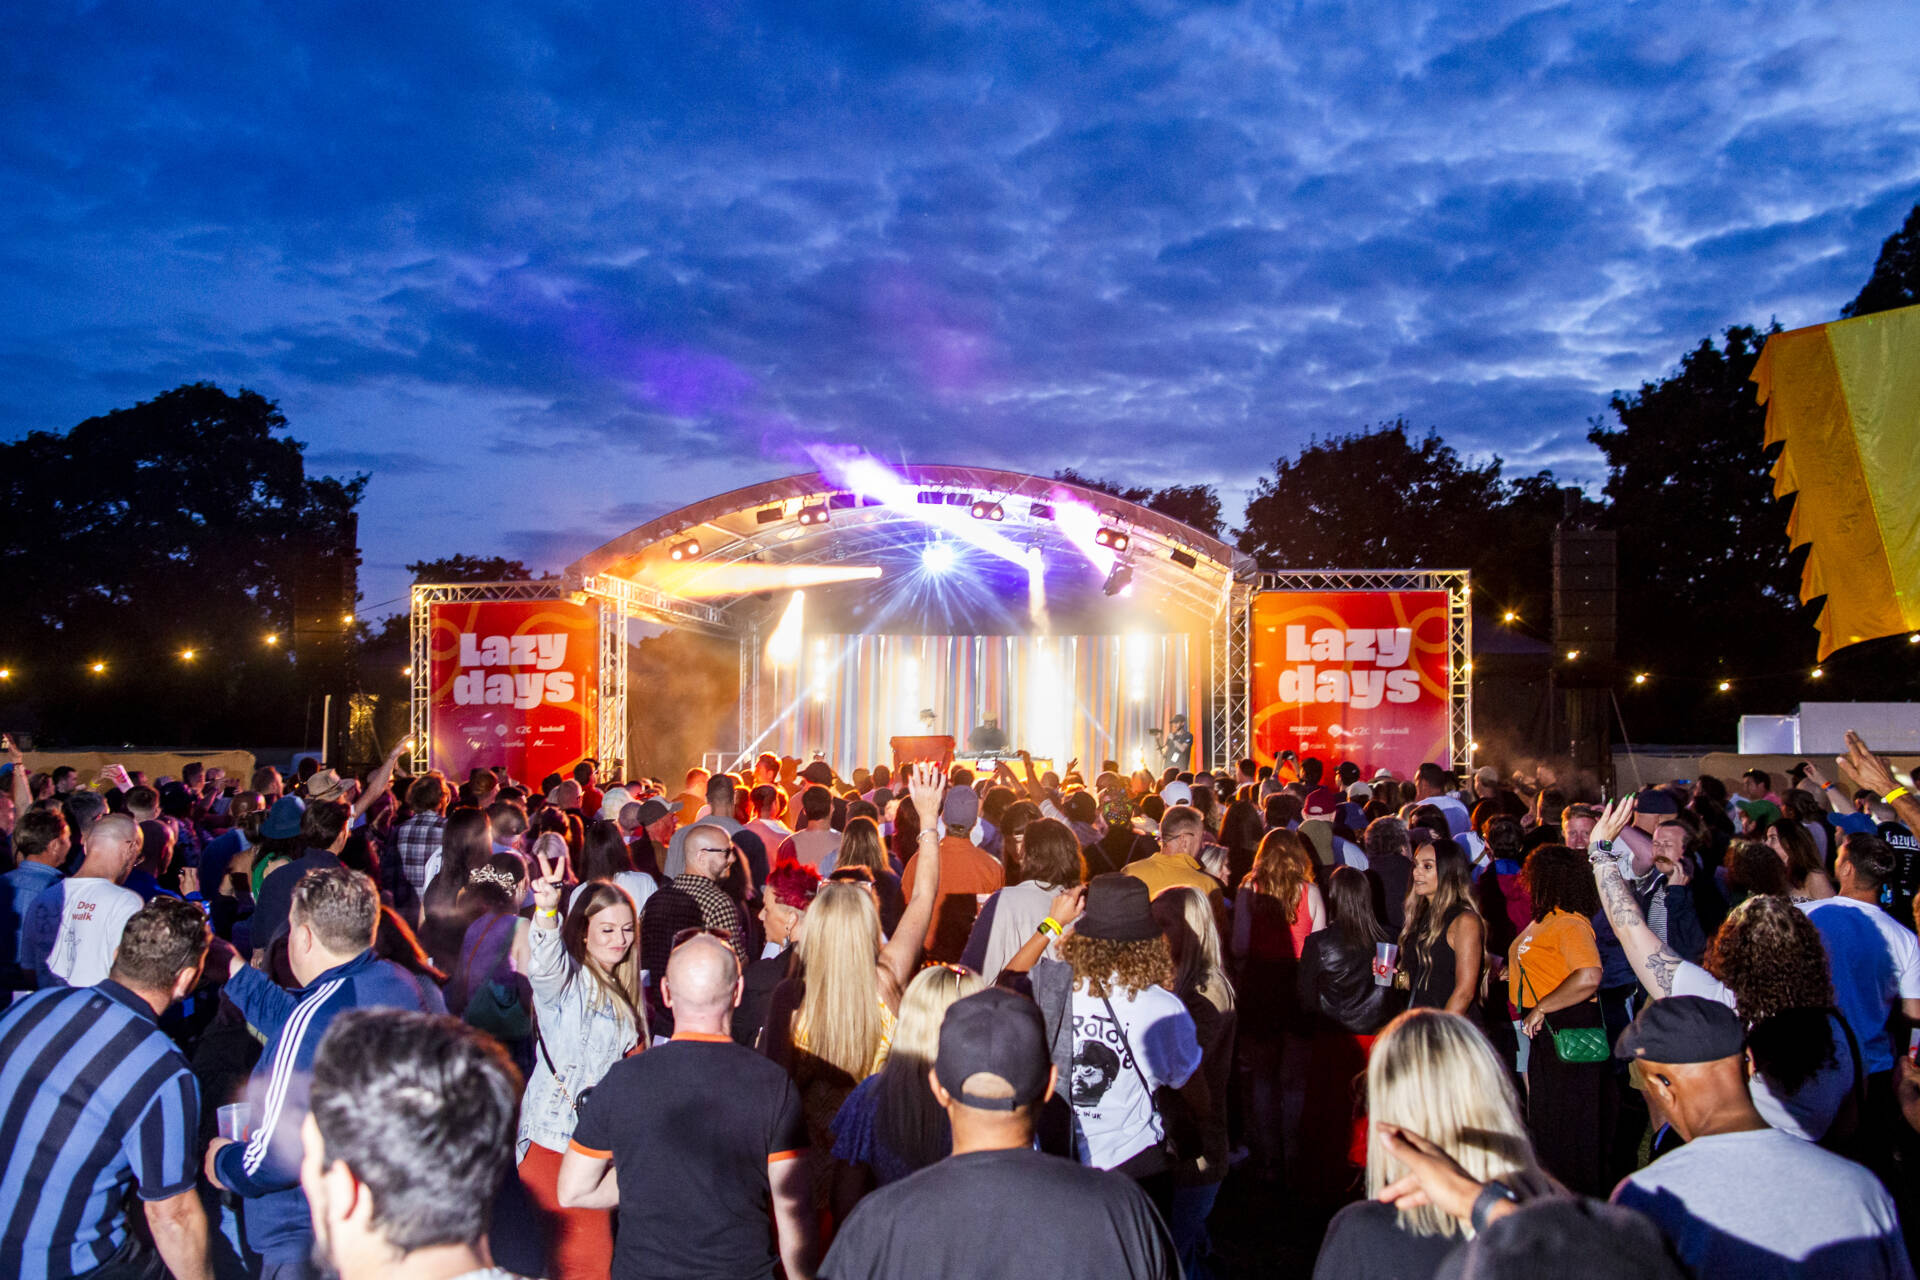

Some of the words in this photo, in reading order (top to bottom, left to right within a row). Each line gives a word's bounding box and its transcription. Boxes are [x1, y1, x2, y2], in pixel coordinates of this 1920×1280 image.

[459, 633, 568, 669] Lazy
[1286, 625, 1412, 667] Lazy
[453, 670, 575, 709] days
[1278, 665, 1421, 709] days
[72, 912, 92, 921] walk
[77, 901, 96, 911] Dog
